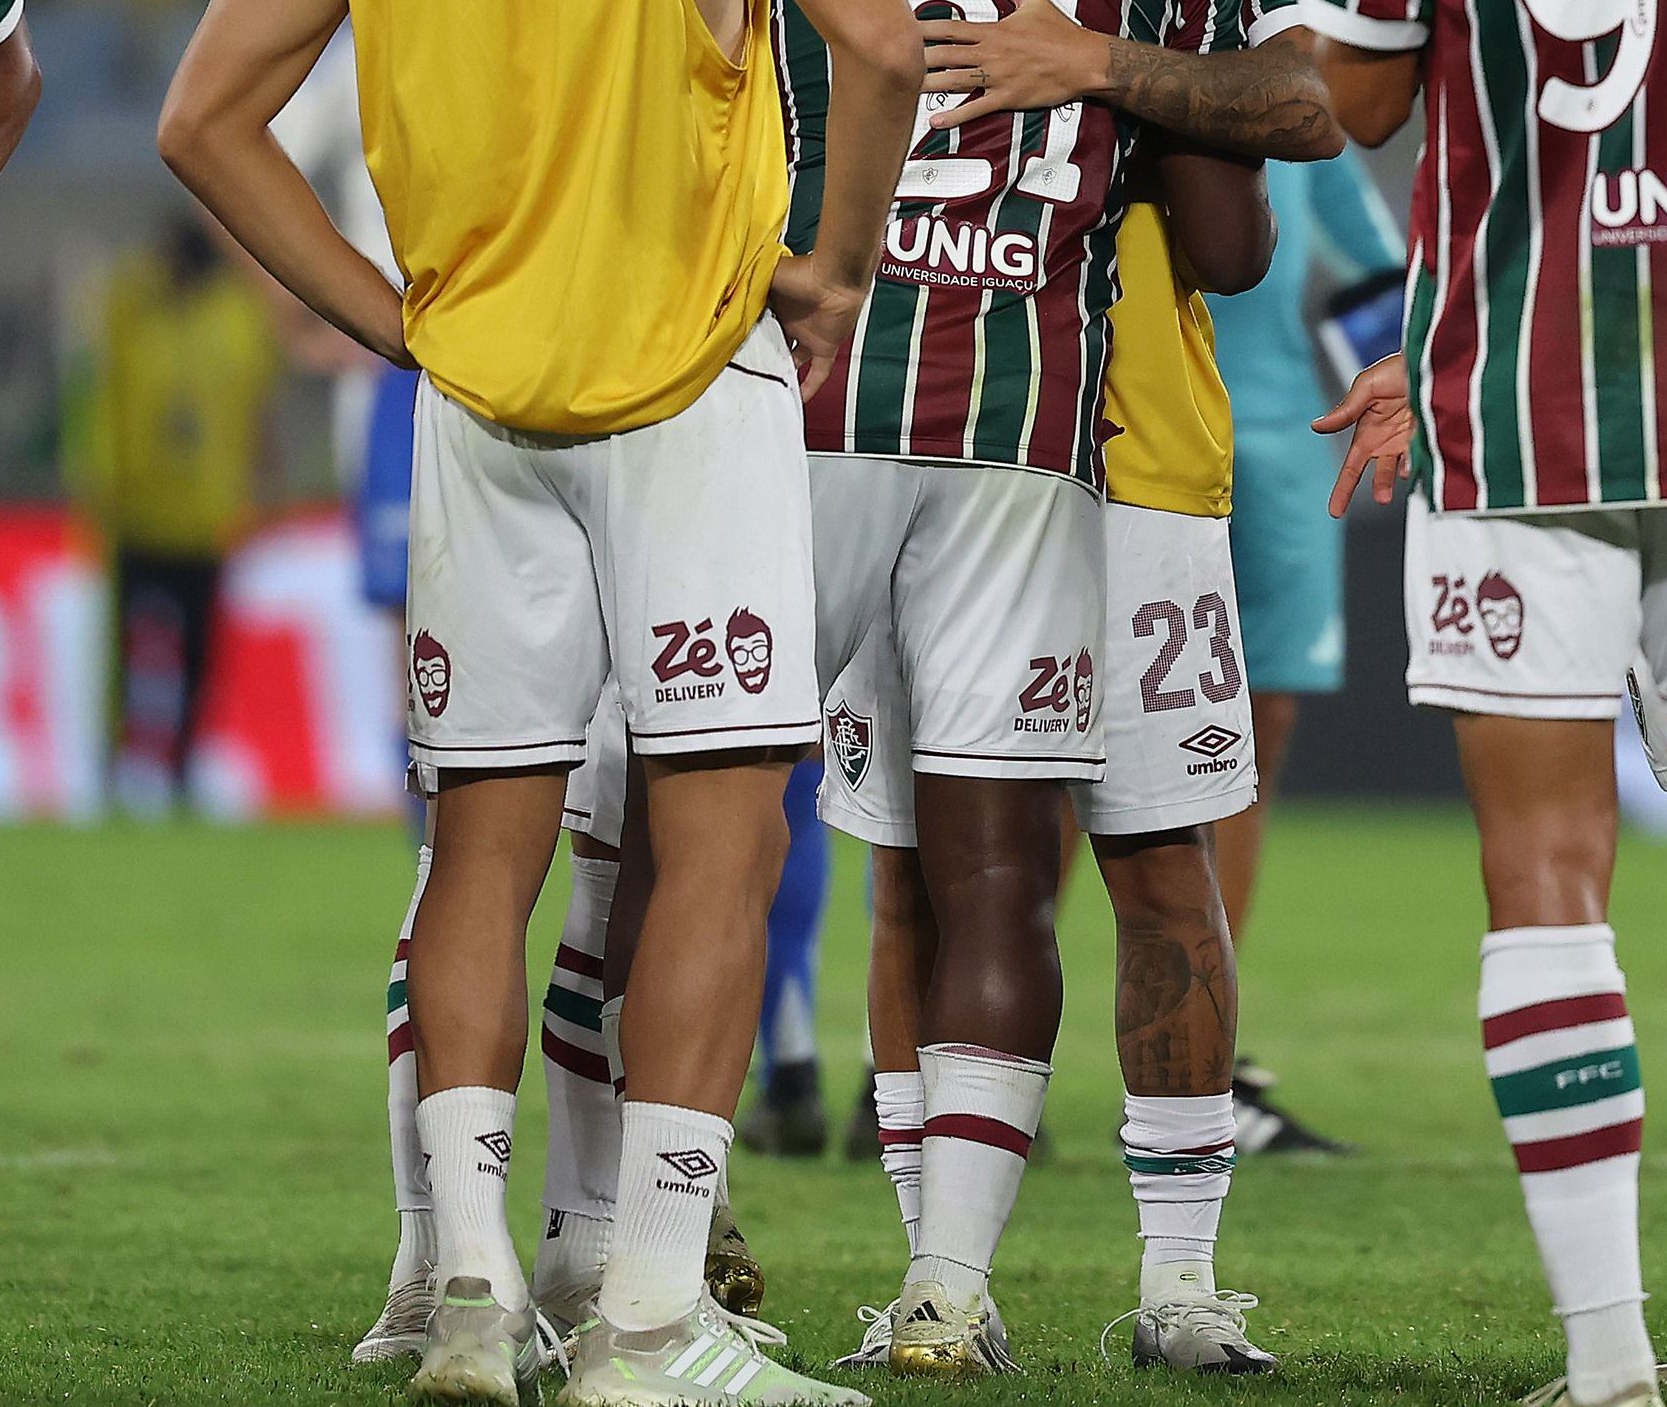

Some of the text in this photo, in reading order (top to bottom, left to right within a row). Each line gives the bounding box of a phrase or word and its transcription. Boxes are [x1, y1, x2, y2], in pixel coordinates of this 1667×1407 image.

[886, 216, 1034, 277] UNIG
[882, 263, 978, 287] UNIVERSIDADE
[1431, 575, 1475, 635] Zé
[651, 618, 724, 683] Zé
[1132, 591, 1242, 713] 23
[655, 683, 725, 703] DELIVERY
[1018, 654, 1072, 714] Zé
[1013, 718, 1070, 733] DELIVERY
[1186, 758, 1238, 776] umbro
[1556, 1060, 1623, 1090] FFC
[477, 1162, 508, 1183] umb
[656, 1178, 709, 1199] umbro
